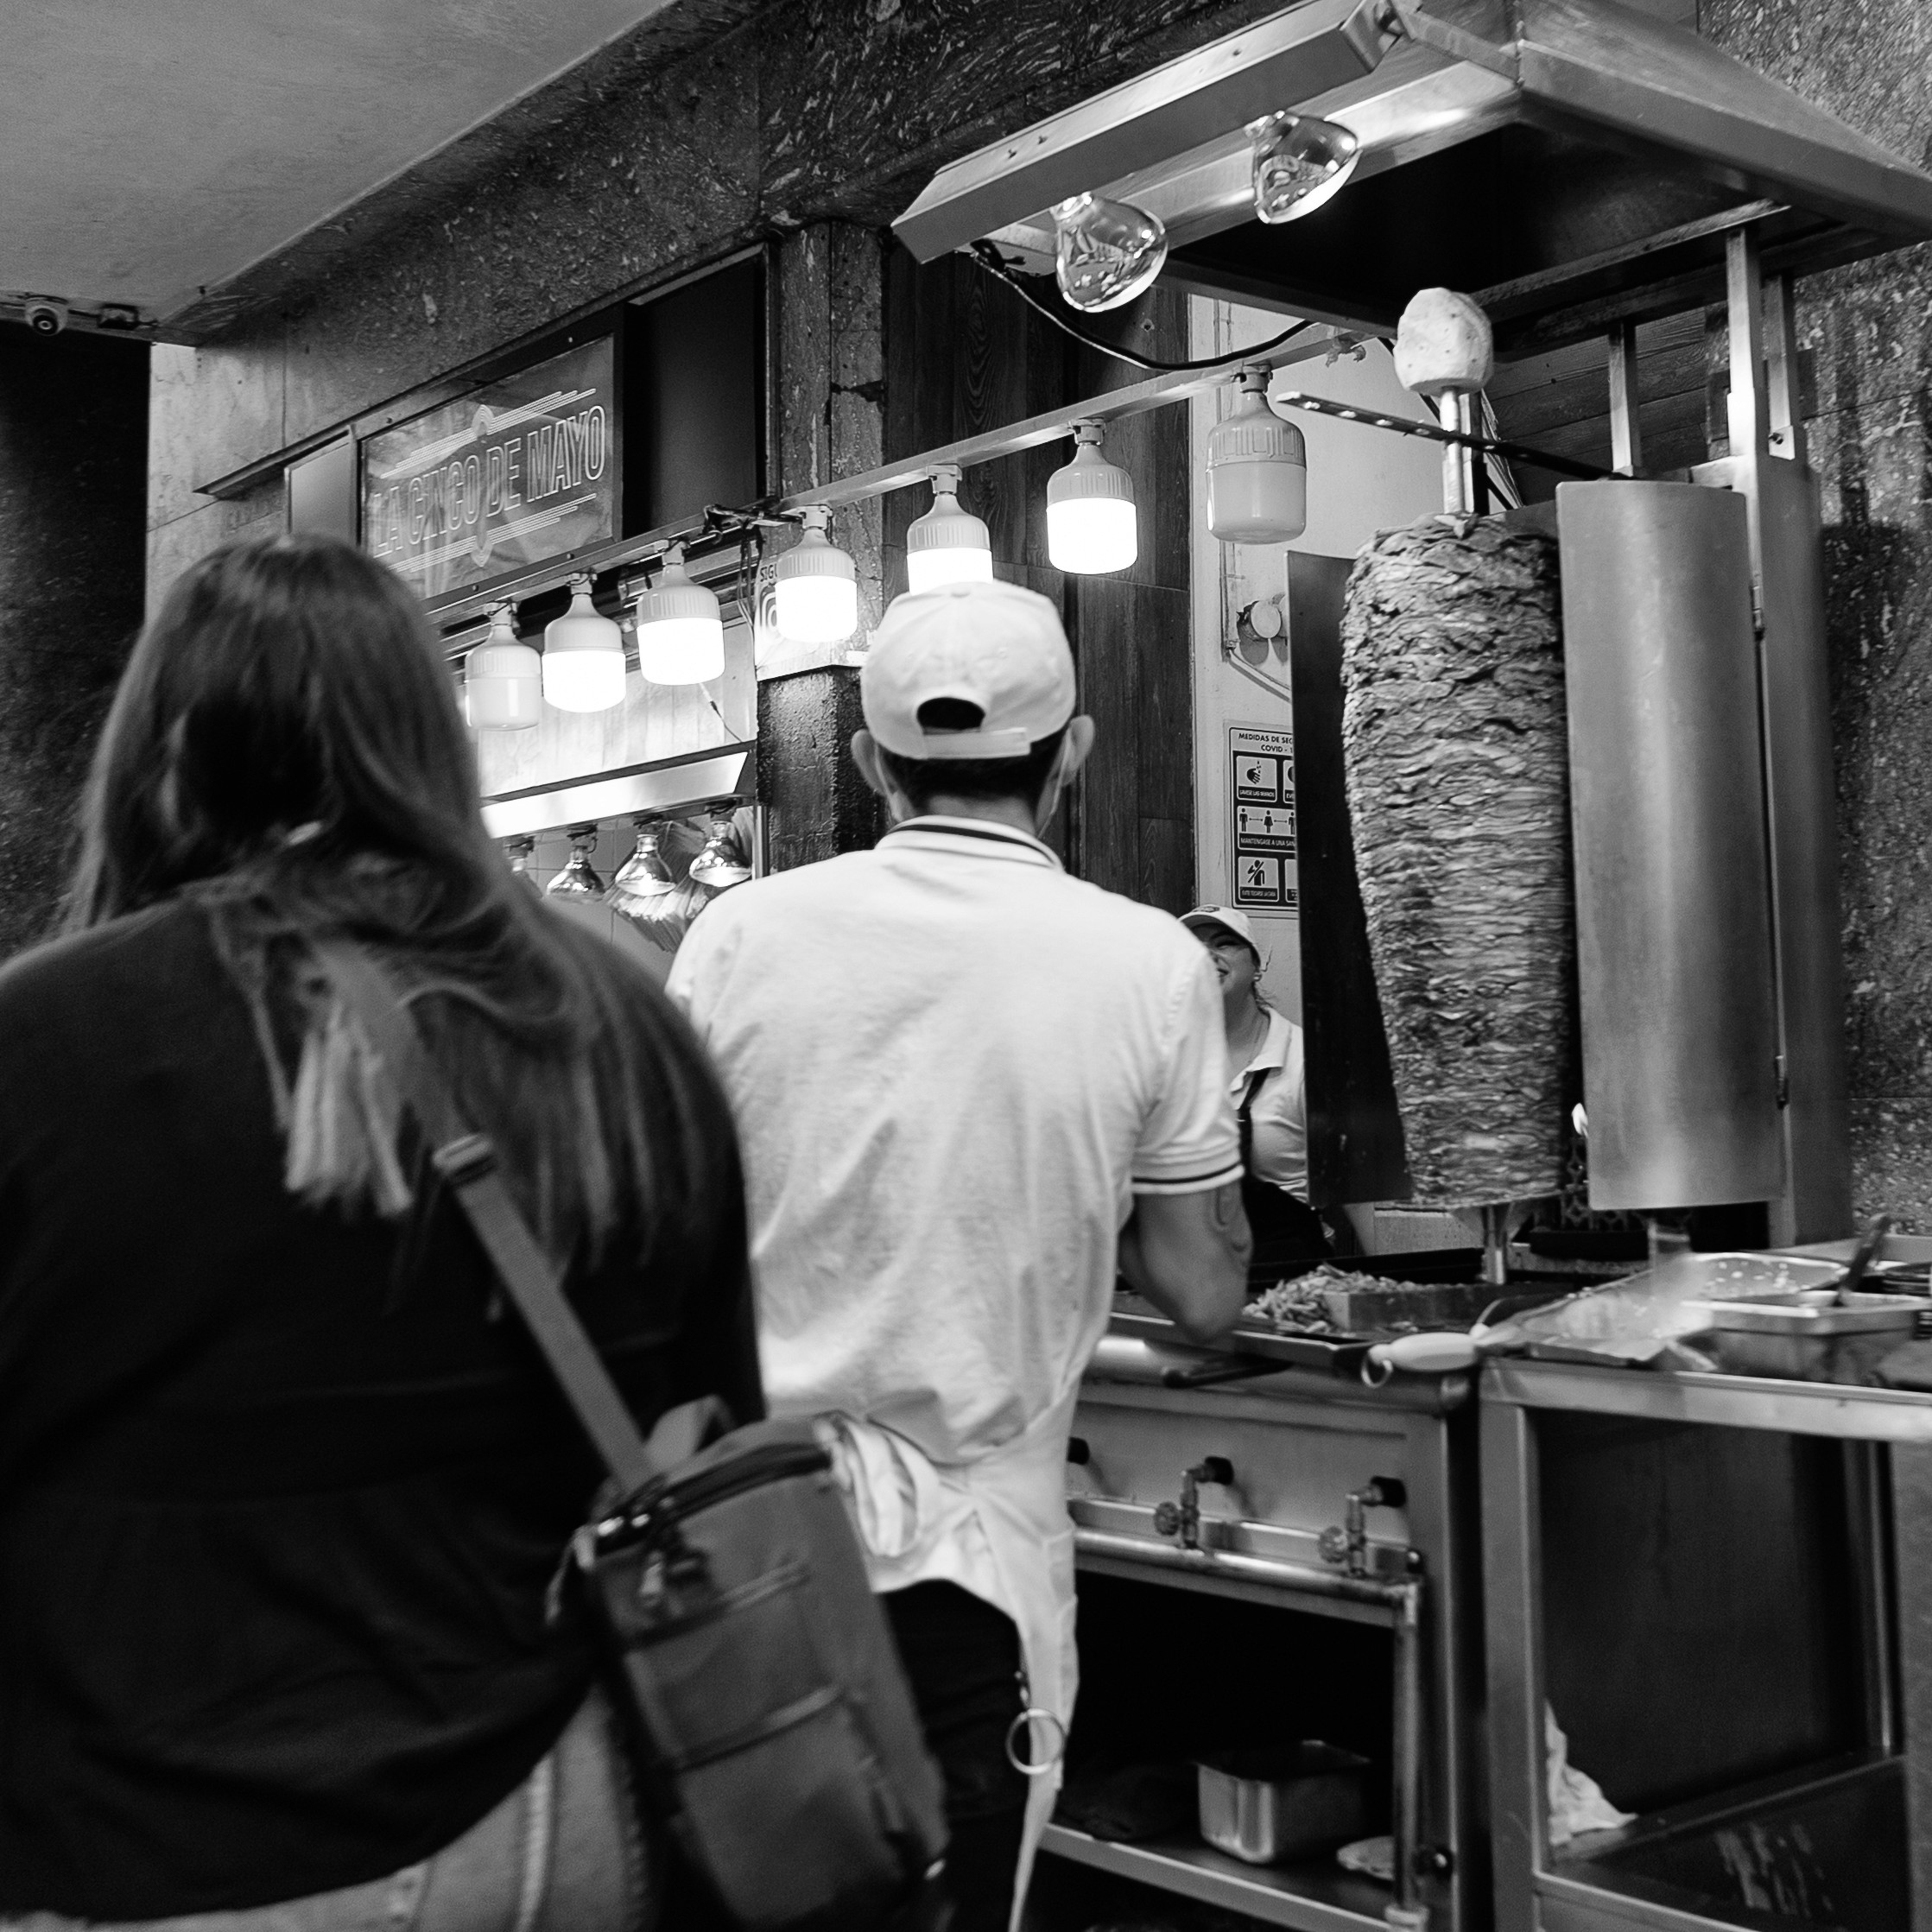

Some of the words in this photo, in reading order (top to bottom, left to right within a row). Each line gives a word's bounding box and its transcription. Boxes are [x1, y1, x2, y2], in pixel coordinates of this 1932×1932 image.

[409, 455, 479, 545] CINCO
[486, 437, 521, 518] DE
[527, 405, 605, 503] MAYO
[1238, 732, 1270, 742] MEDIDAS
[1261, 744, 1283, 752] COVID
